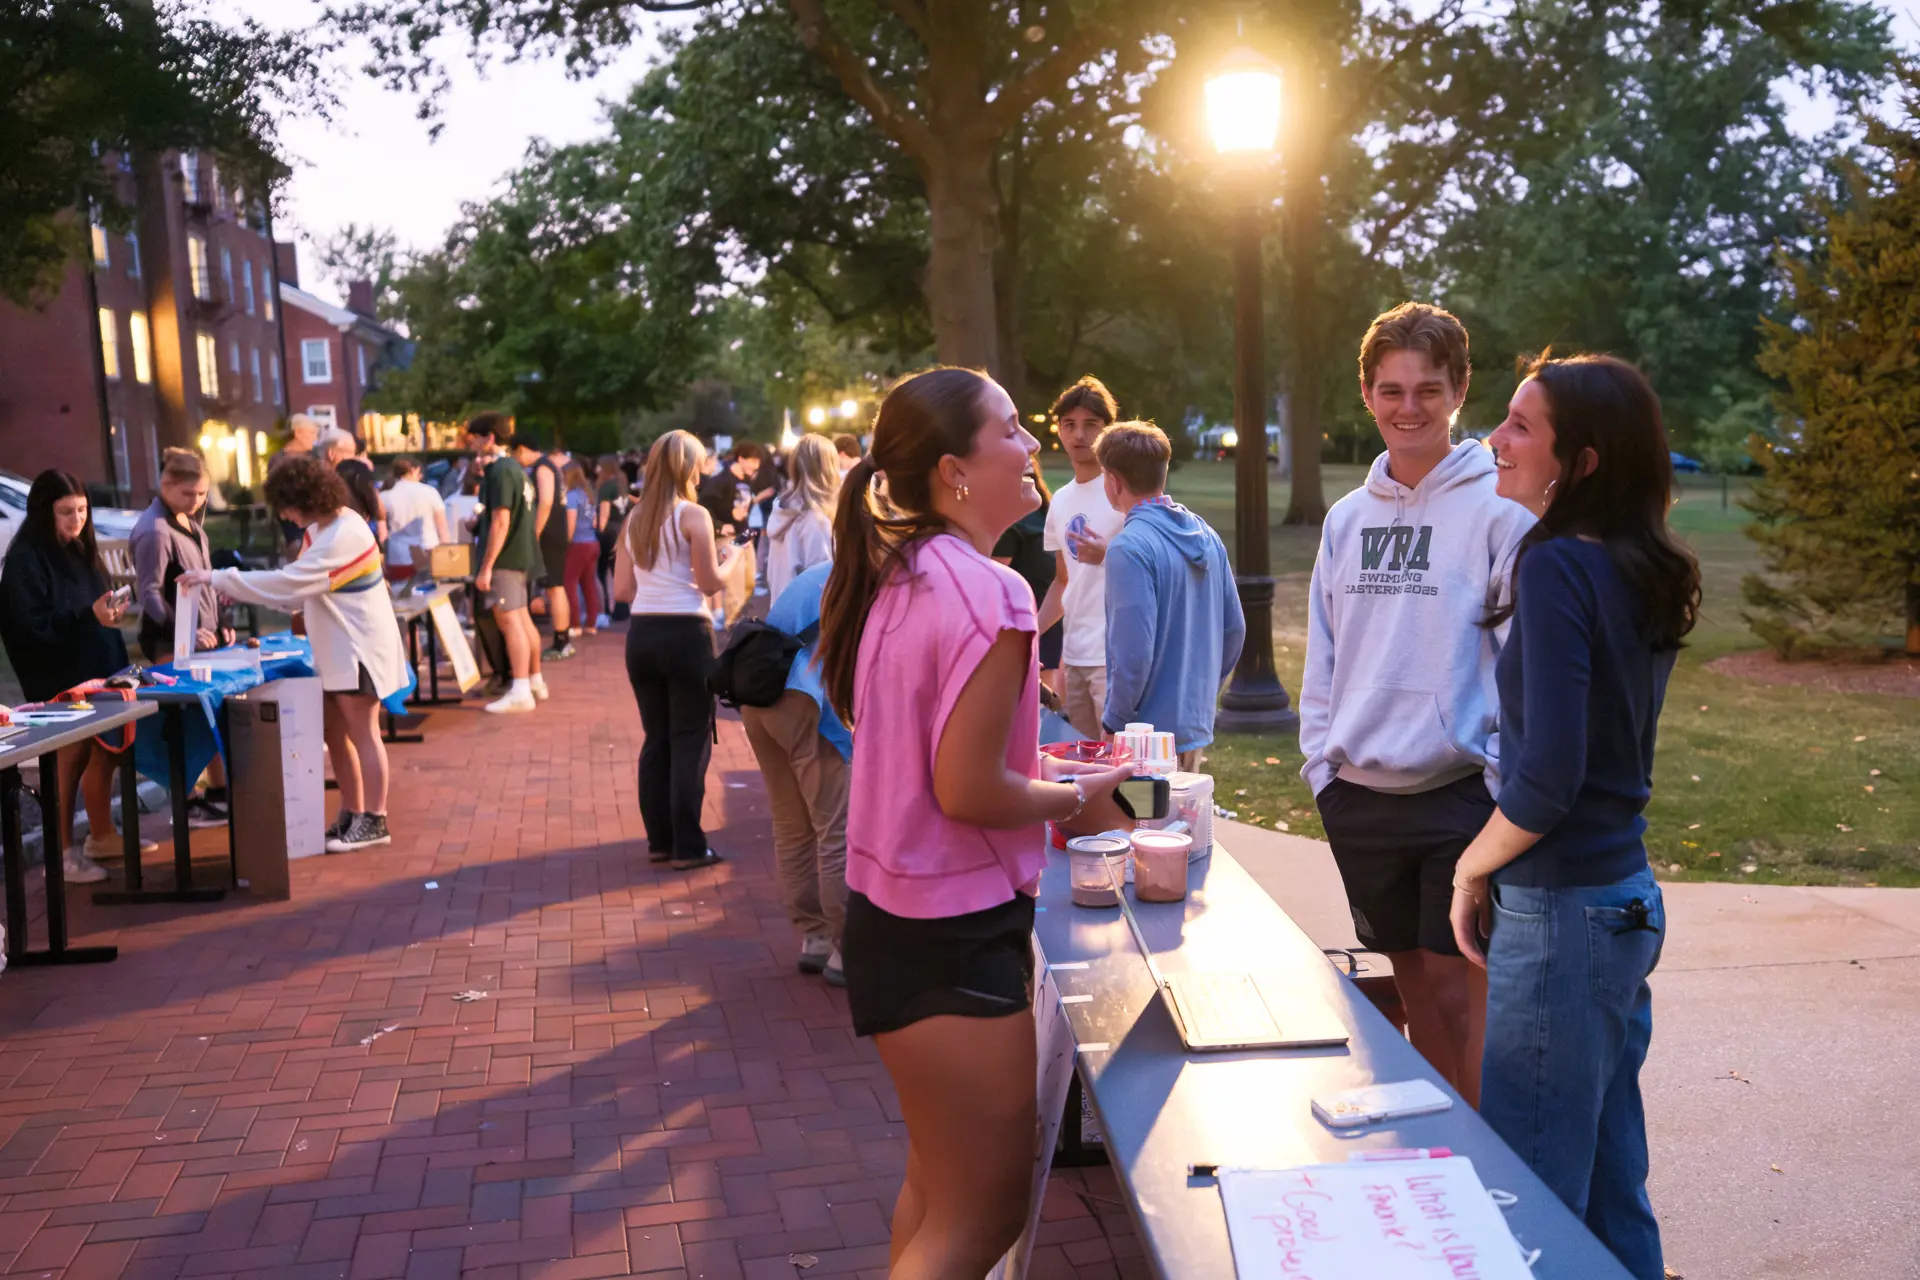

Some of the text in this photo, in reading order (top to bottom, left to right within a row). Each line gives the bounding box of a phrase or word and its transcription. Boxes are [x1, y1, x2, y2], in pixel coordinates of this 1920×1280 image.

[1360, 525, 1433, 571] WRA
[1403, 583, 1440, 597] 2025
[1405, 1174, 1481, 1280] What is You
